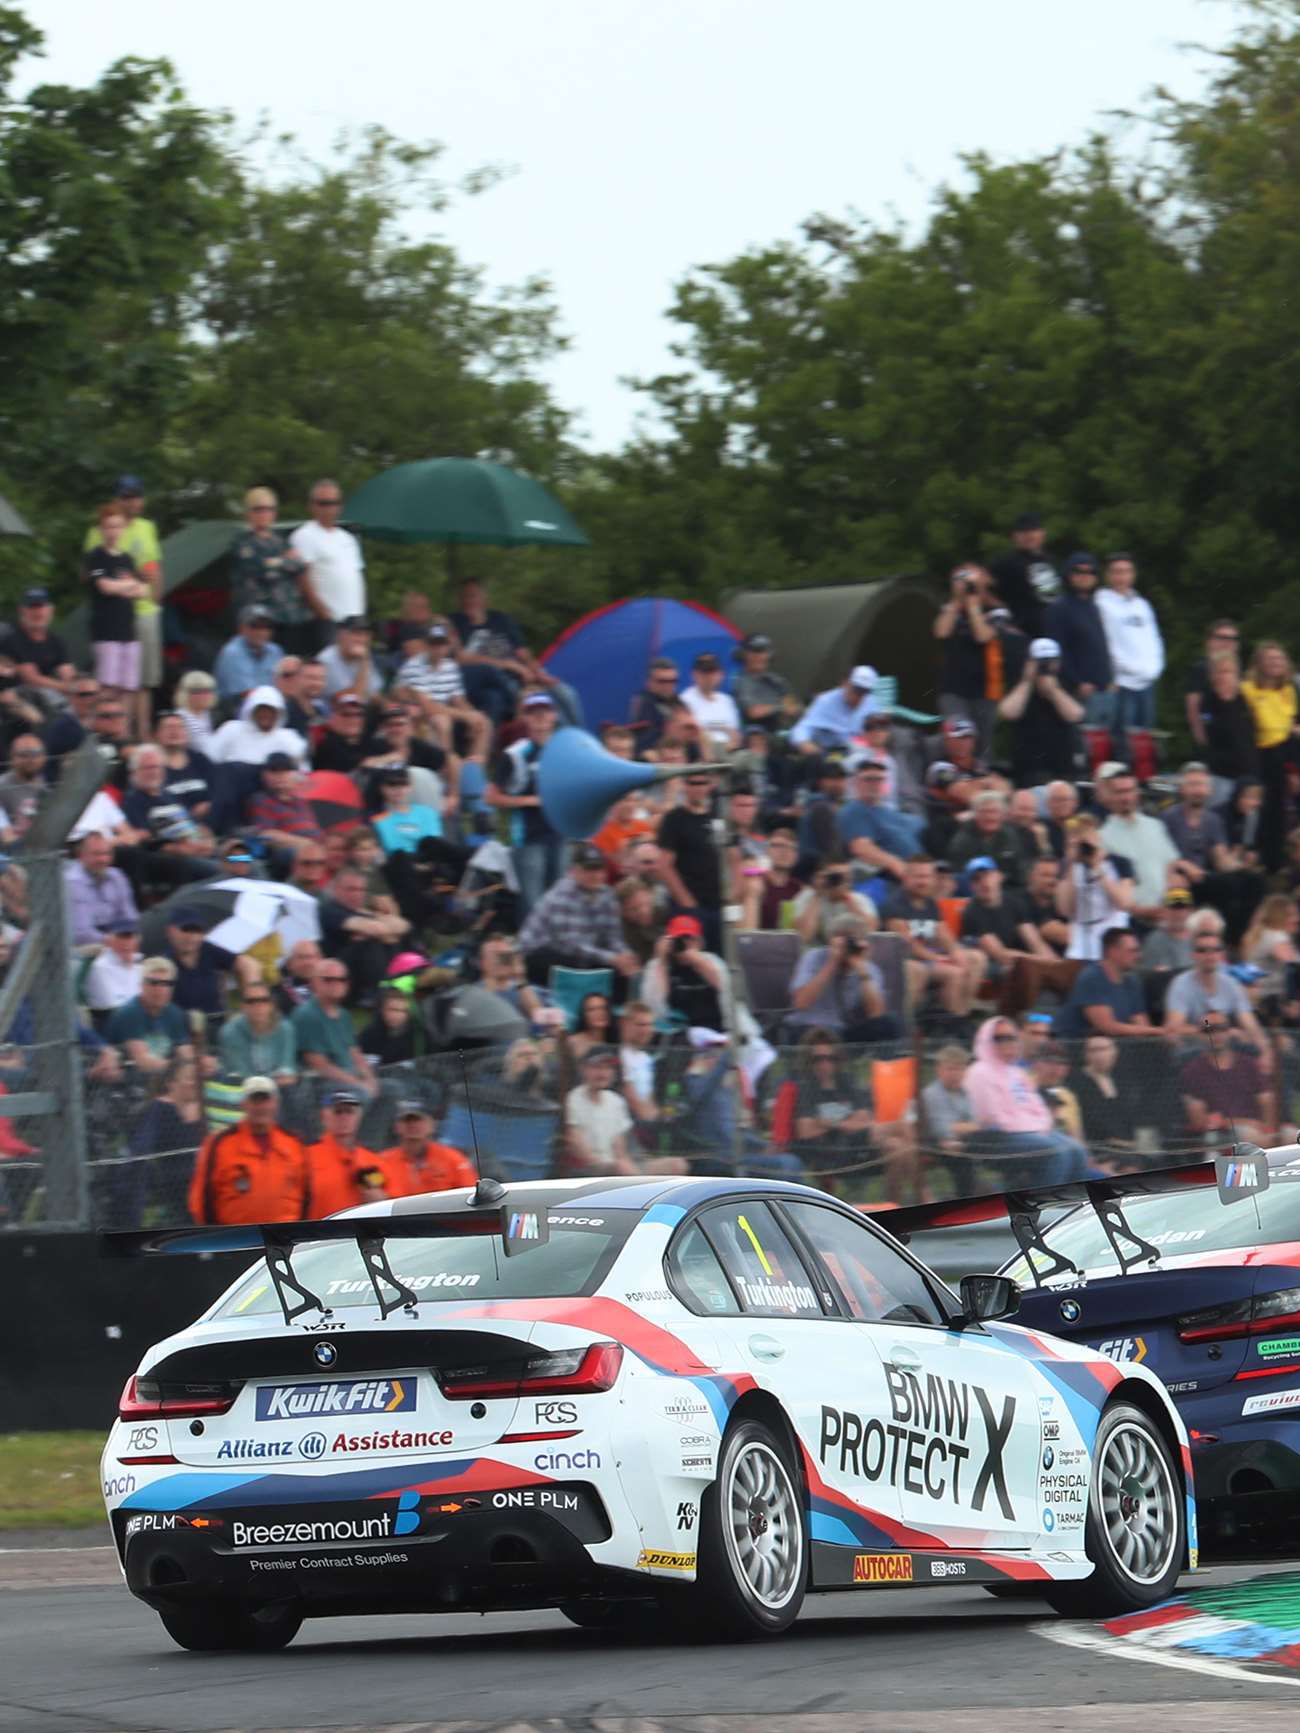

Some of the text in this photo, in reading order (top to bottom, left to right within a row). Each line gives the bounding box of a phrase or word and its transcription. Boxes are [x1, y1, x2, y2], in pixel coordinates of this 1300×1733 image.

[547, 1216, 604, 1226] ence
[737, 1216, 773, 1275] 1
[625, 1290, 672, 1302] POPULOUS
[736, 1276, 817, 1313] Turkington
[1167, 1381, 1197, 1392] RIES
[883, 1362, 968, 1441] BMW
[217, 1438, 293, 1459] Allianz
[332, 1430, 453, 1452] Assistance
[534, 1447, 601, 1471] cinch
[820, 1405, 969, 1504] PROTECT
[1040, 1475, 1087, 1487] PHYSICAL
[492, 1491, 578, 1510] ONE PLM
[1044, 1490, 1082, 1502] DIGITAL
[143, 1515, 175, 1530] PLM
[233, 1513, 391, 1545] Breezemount
[250, 1552, 409, 1571] Premier Contract Supplies
[649, 1553, 696, 1567] DUNLOP
[854, 1556, 912, 1580] AUTOCAR
